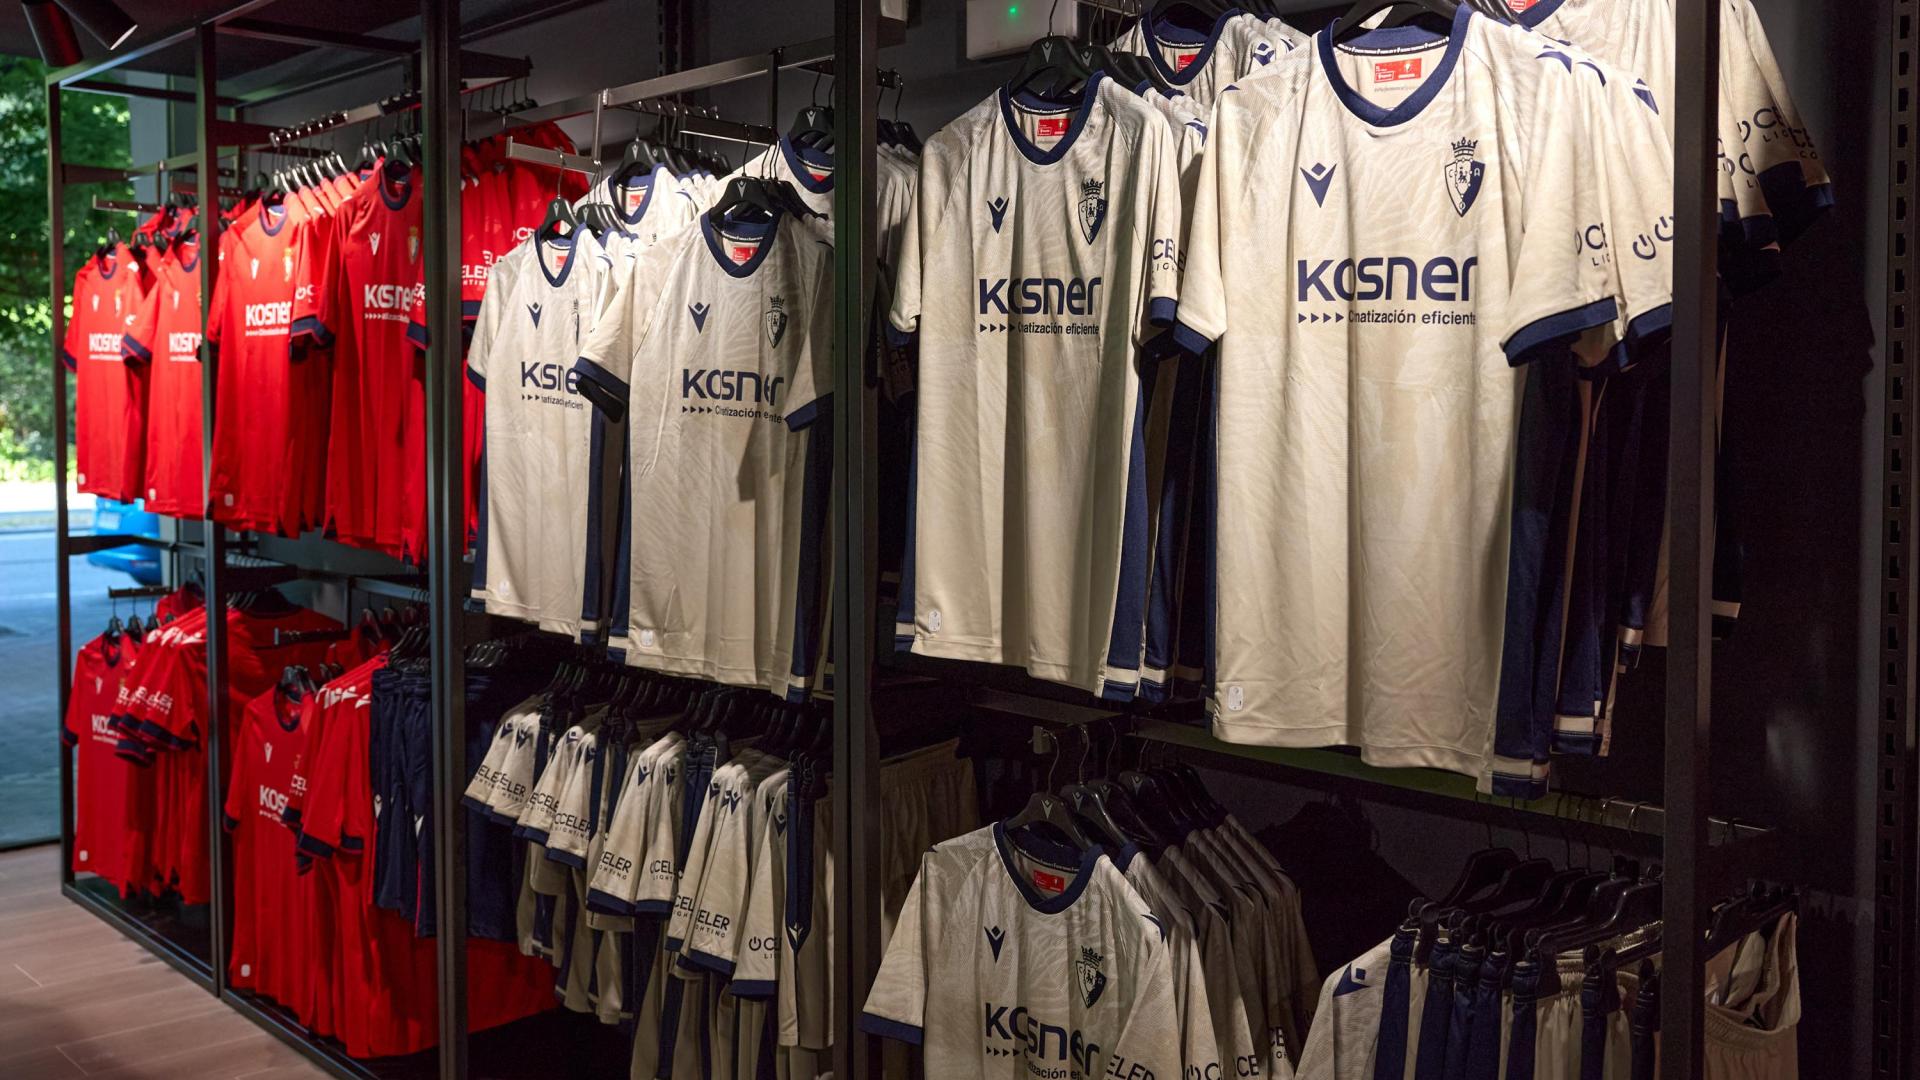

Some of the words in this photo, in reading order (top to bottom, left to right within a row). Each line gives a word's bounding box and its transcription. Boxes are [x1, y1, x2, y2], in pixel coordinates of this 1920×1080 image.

[1298, 256, 1478, 302] Kosner
[601, 851, 632, 873] ELER
[698, 909, 730, 931] ELER
